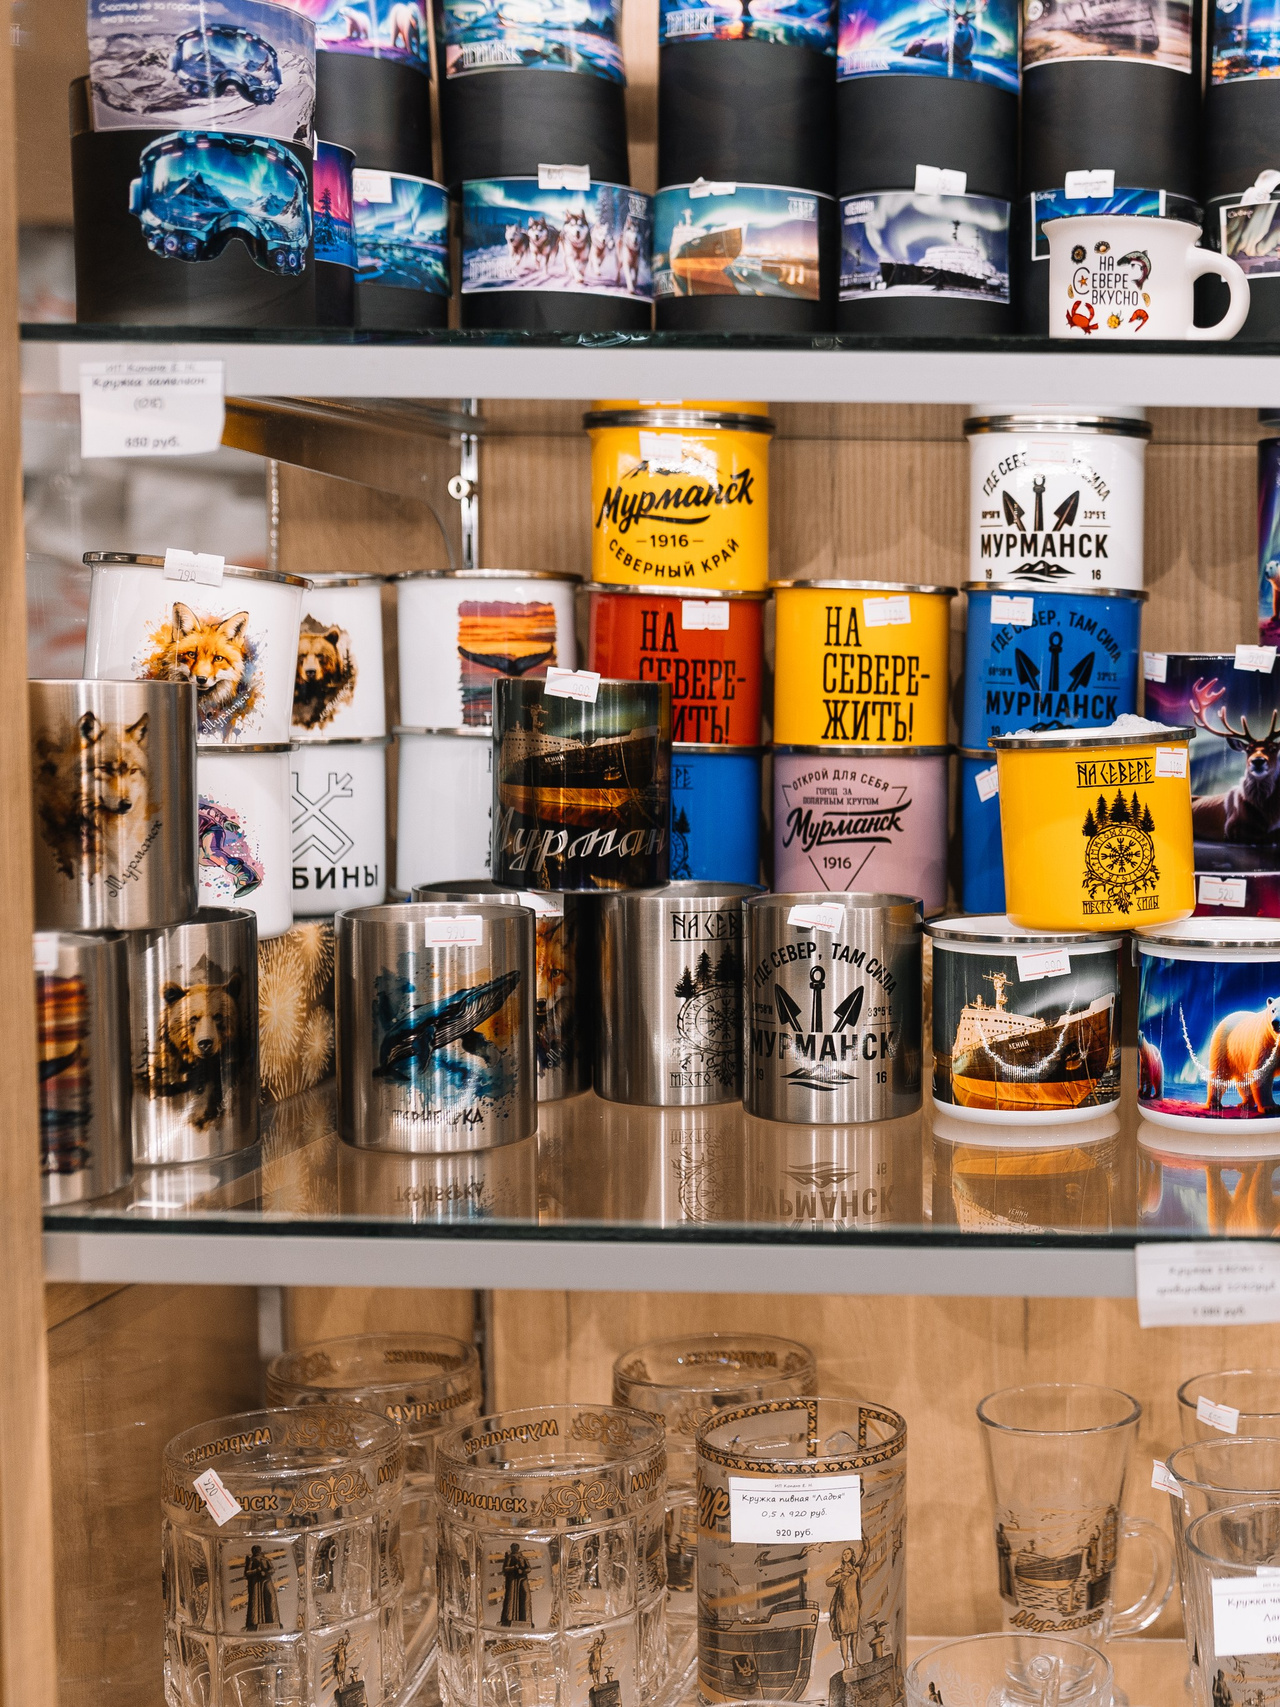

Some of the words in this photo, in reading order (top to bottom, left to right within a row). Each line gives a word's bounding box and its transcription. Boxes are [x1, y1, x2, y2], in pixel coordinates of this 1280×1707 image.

[1099, 255, 1114, 271] НА
[1091, 289, 1139, 306] ВКУСНО
[595, 468, 755, 534] Мурманск
[649, 534, 690, 548] 1916
[980, 532, 1109, 559] МУРМАНСК
[608, 538, 696, 579] СЕВЕРНЫЙ
[700, 537, 740, 574] КРАЙ
[985, 568, 993, 580] 19
[1091, 568, 1102, 581] 16
[639, 609, 679, 653] НА
[824, 606, 863, 647] НА
[990, 625, 1014, 654] ГДЕ
[1068, 610, 1100, 637] ТАМ
[1096, 627, 1123, 664] СИЛА
[822, 652, 931, 697] СЕВЕРЕ-
[986, 690, 1119, 720] МУРМАНСК
[821, 699, 914, 742] ЖИТЬ!
[991, 724, 1000, 737] 19
[793, 768, 829, 791] ОТКРОЙ
[832, 768, 856, 781] ДЛЯ
[860, 773, 890, 792] СЕБЯ
[816, 787, 838, 796] ГОРОД
[843, 787, 853, 796] ЗА
[847, 797, 880, 806] КРУГОМ
[782, 803, 907, 853] Мурманск
[104, 820, 163, 898] Мурманск
[823, 856, 852, 870] 1916
[770, 941, 822, 969] СЕВЕР,
[832, 942, 866, 969] ТАМ
[865, 957, 898, 996] СИЛА
[750, 1031, 896, 1062] МУРМАНСК
[755, 1068, 764, 1081] 19
[876, 1072, 888, 1084] 16
[741, 1493, 776, 1504] Кружка
[779, 1494, 809, 1503] пивная
[812, 1492, 845, 1502] "Ладья"
[761, 1510, 777, 1519] 0,5
[789, 1510, 807, 1518] 920
[810, 1507, 828, 1519] руб.
[776, 1529, 792, 1537] 920
[794, 1528, 814, 1538] руб.
[1227, 1598, 1267, 1609] Кружка
